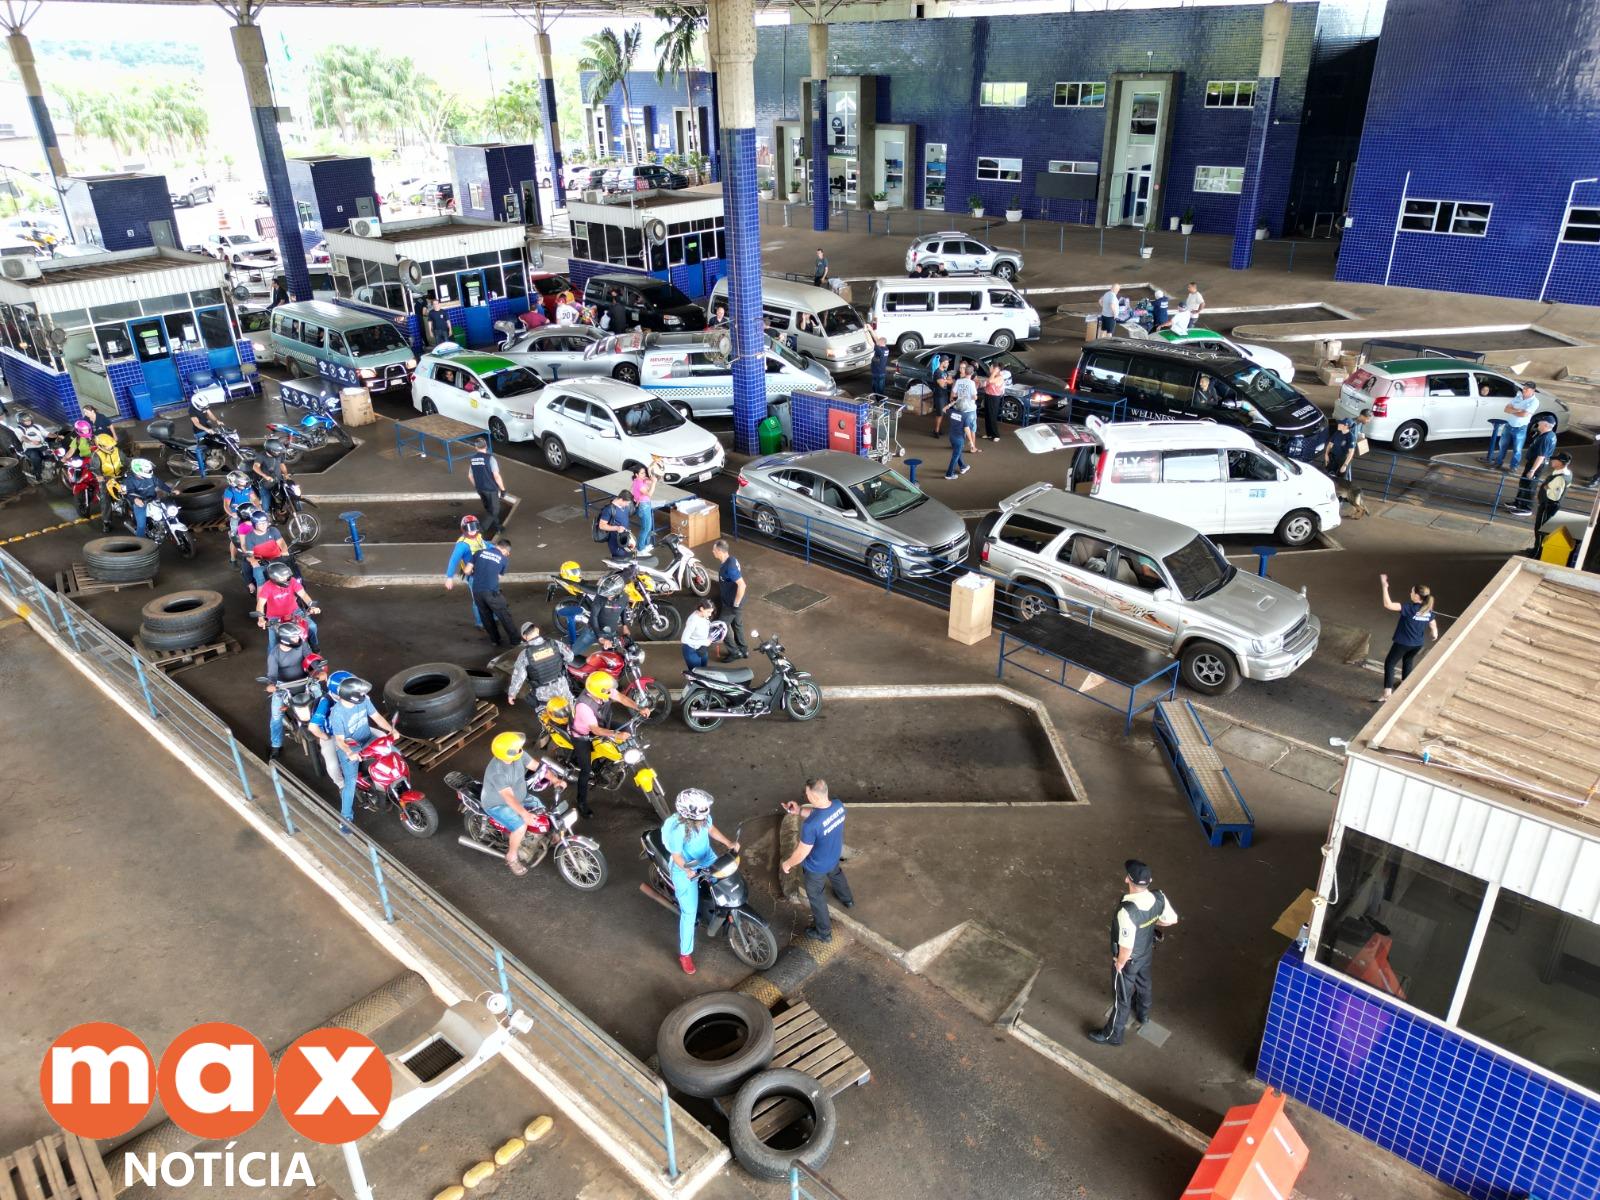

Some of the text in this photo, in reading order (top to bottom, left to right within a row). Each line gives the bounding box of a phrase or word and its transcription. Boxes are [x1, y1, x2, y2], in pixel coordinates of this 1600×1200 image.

[562, 312, 571, 320] 20
[1131, 408, 1176, 422] WELLNESS
[822, 806, 845, 828] RECEITA
